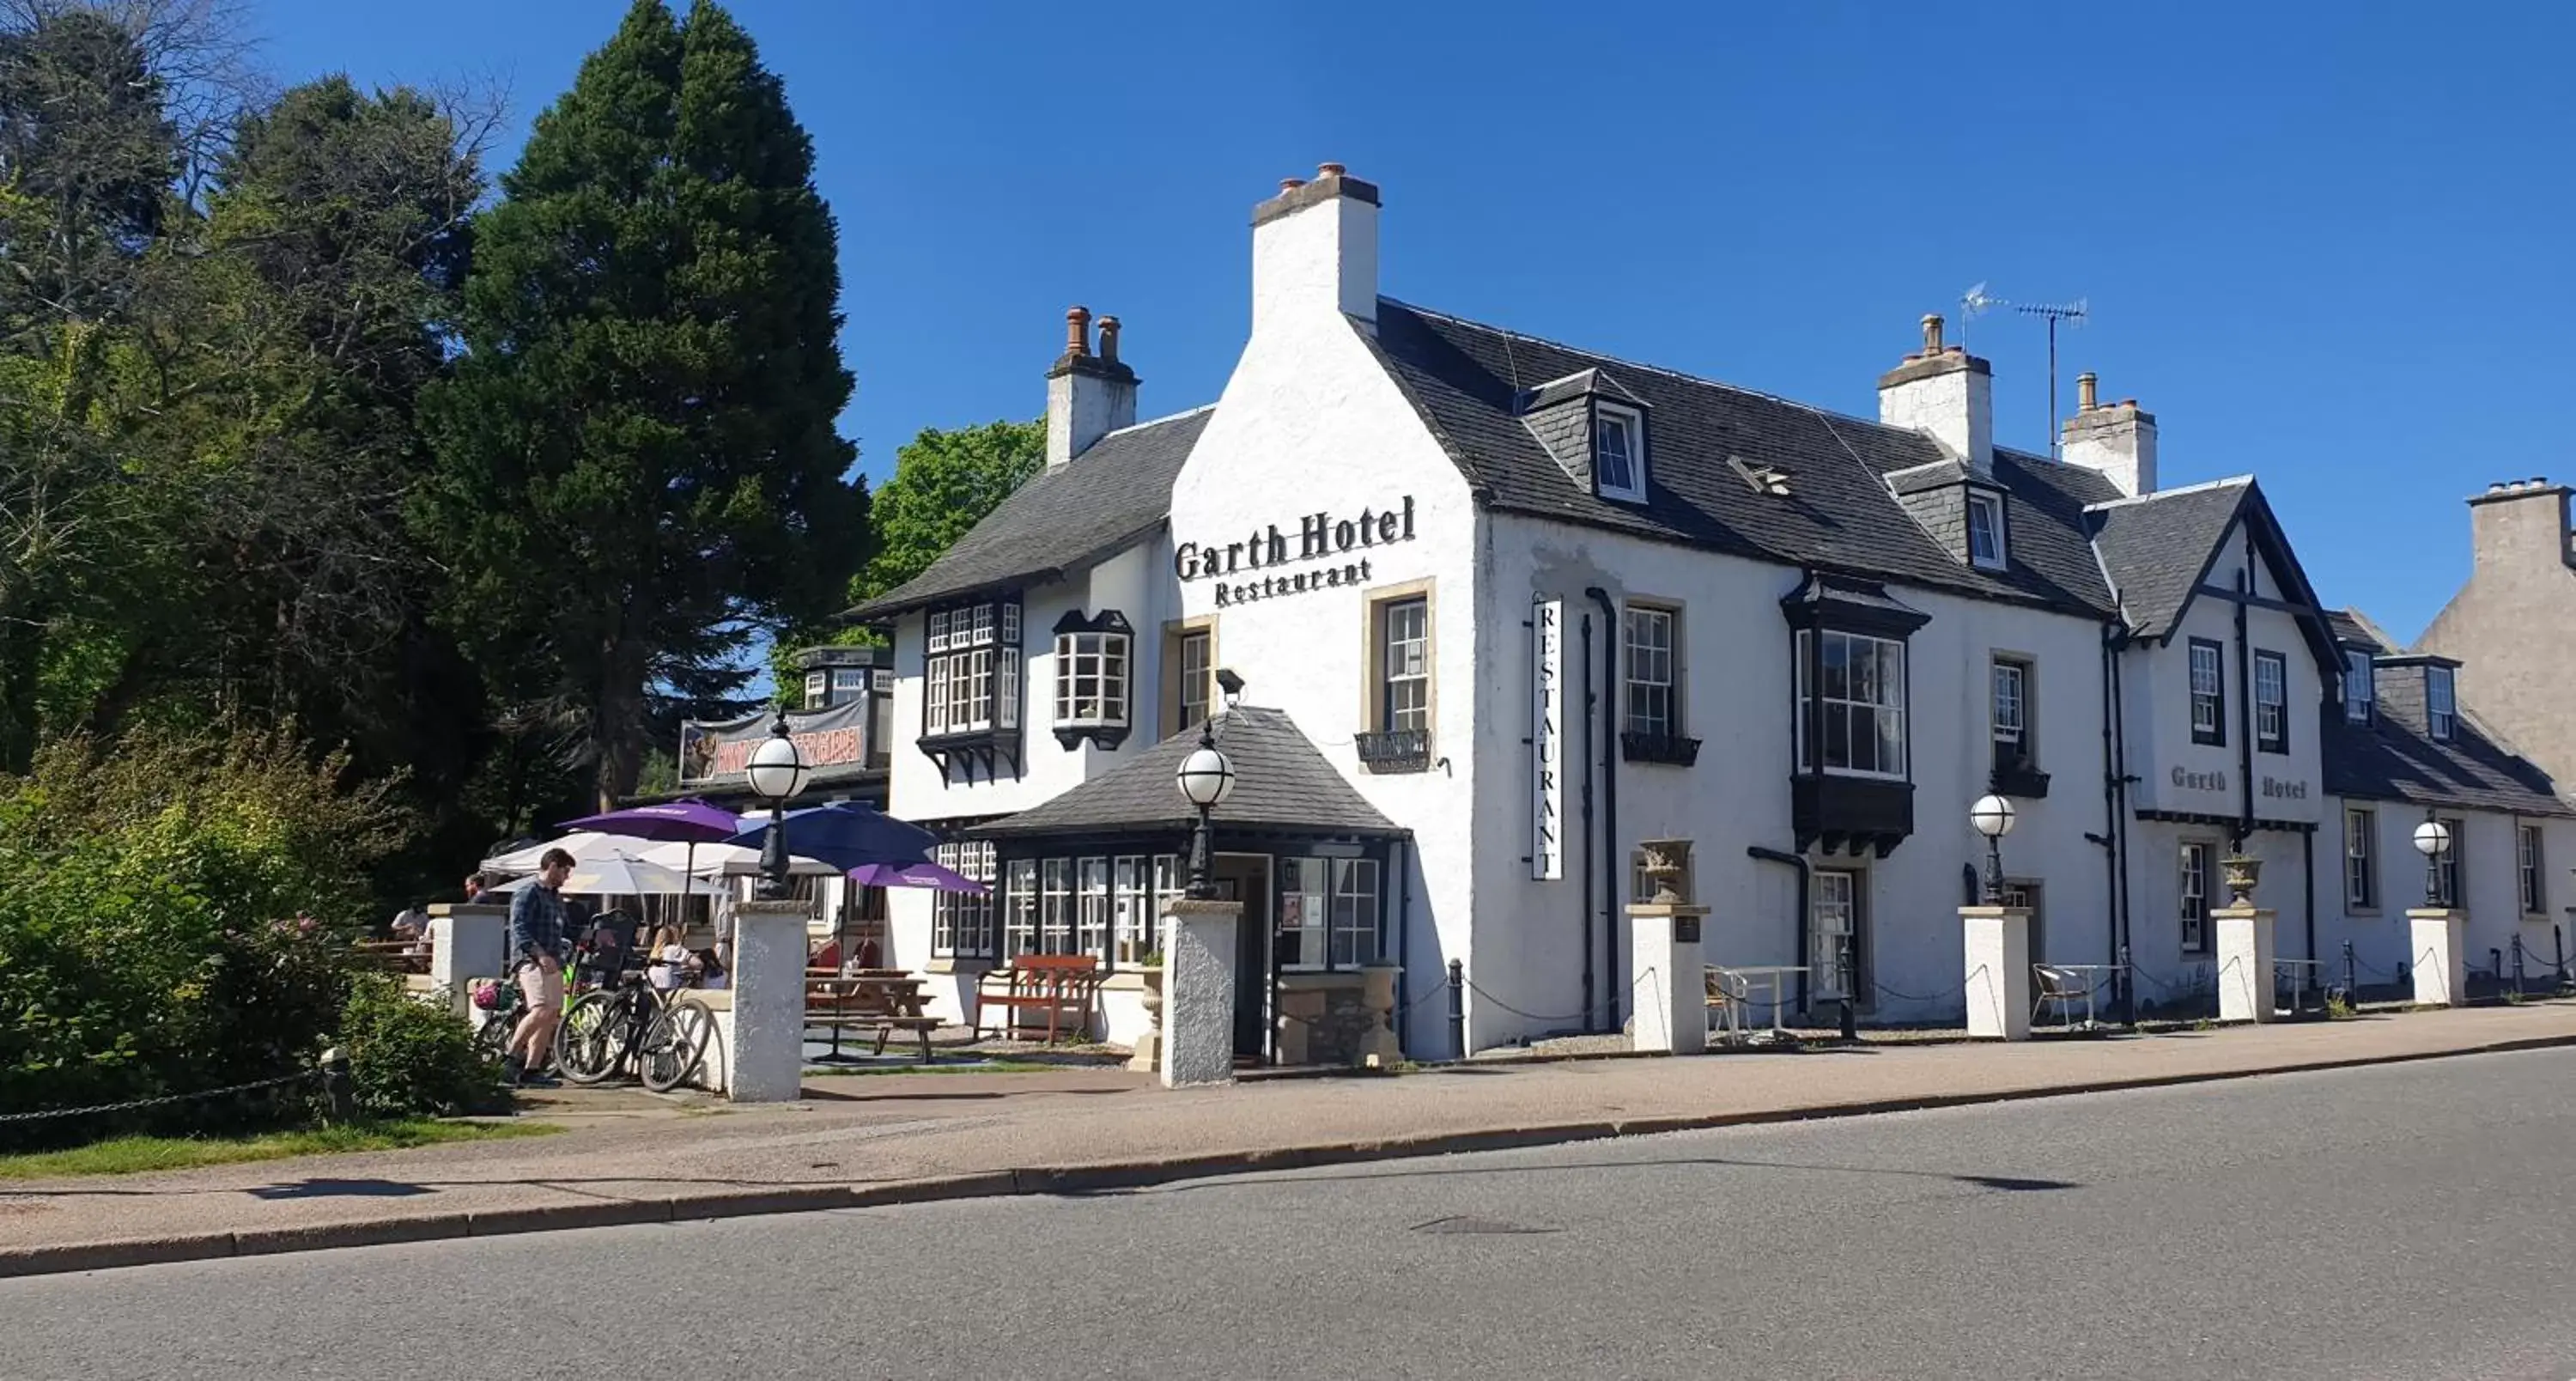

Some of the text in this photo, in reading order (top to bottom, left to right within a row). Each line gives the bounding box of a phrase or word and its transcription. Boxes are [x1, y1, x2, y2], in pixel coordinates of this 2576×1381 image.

[1176, 495, 1416, 581] Garth Hotel
[1214, 557, 1371, 608] Restaurant
[1539, 608, 1555, 873] RESTAURANT
[2171, 764, 2308, 800] Garth Hotel
